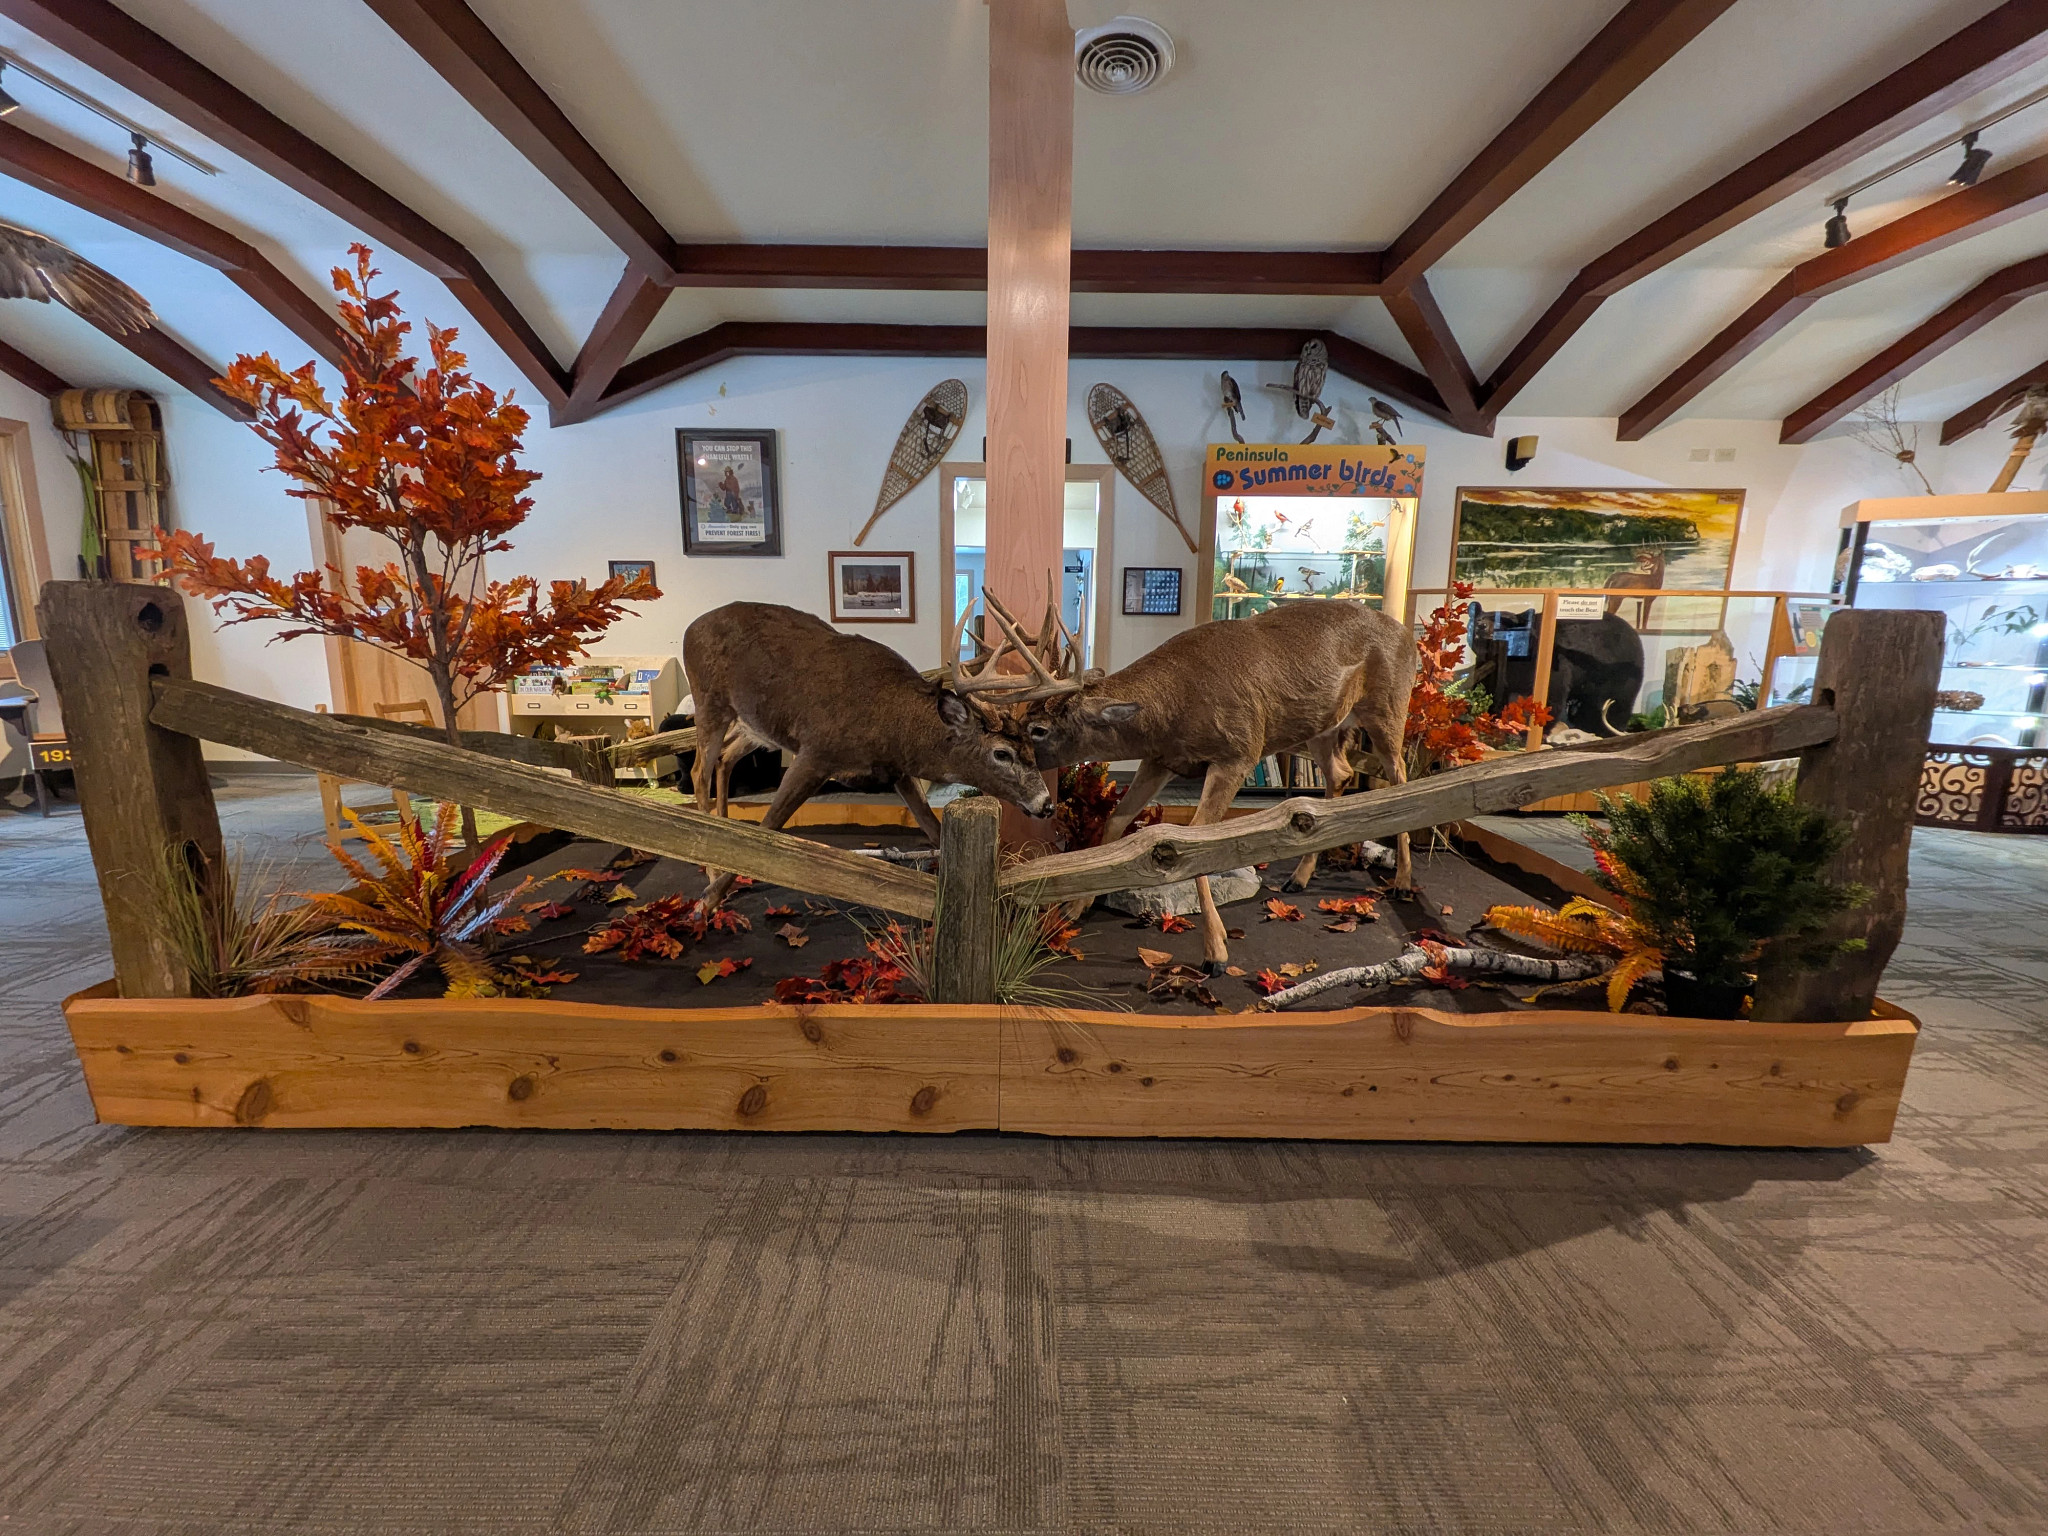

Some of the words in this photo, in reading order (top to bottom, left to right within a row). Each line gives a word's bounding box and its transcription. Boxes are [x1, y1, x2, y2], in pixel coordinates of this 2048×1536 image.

[1216, 447, 1288, 462] Peninsula
[1239, 463, 1333, 490] Summer
[1339, 458, 1397, 490] birds
